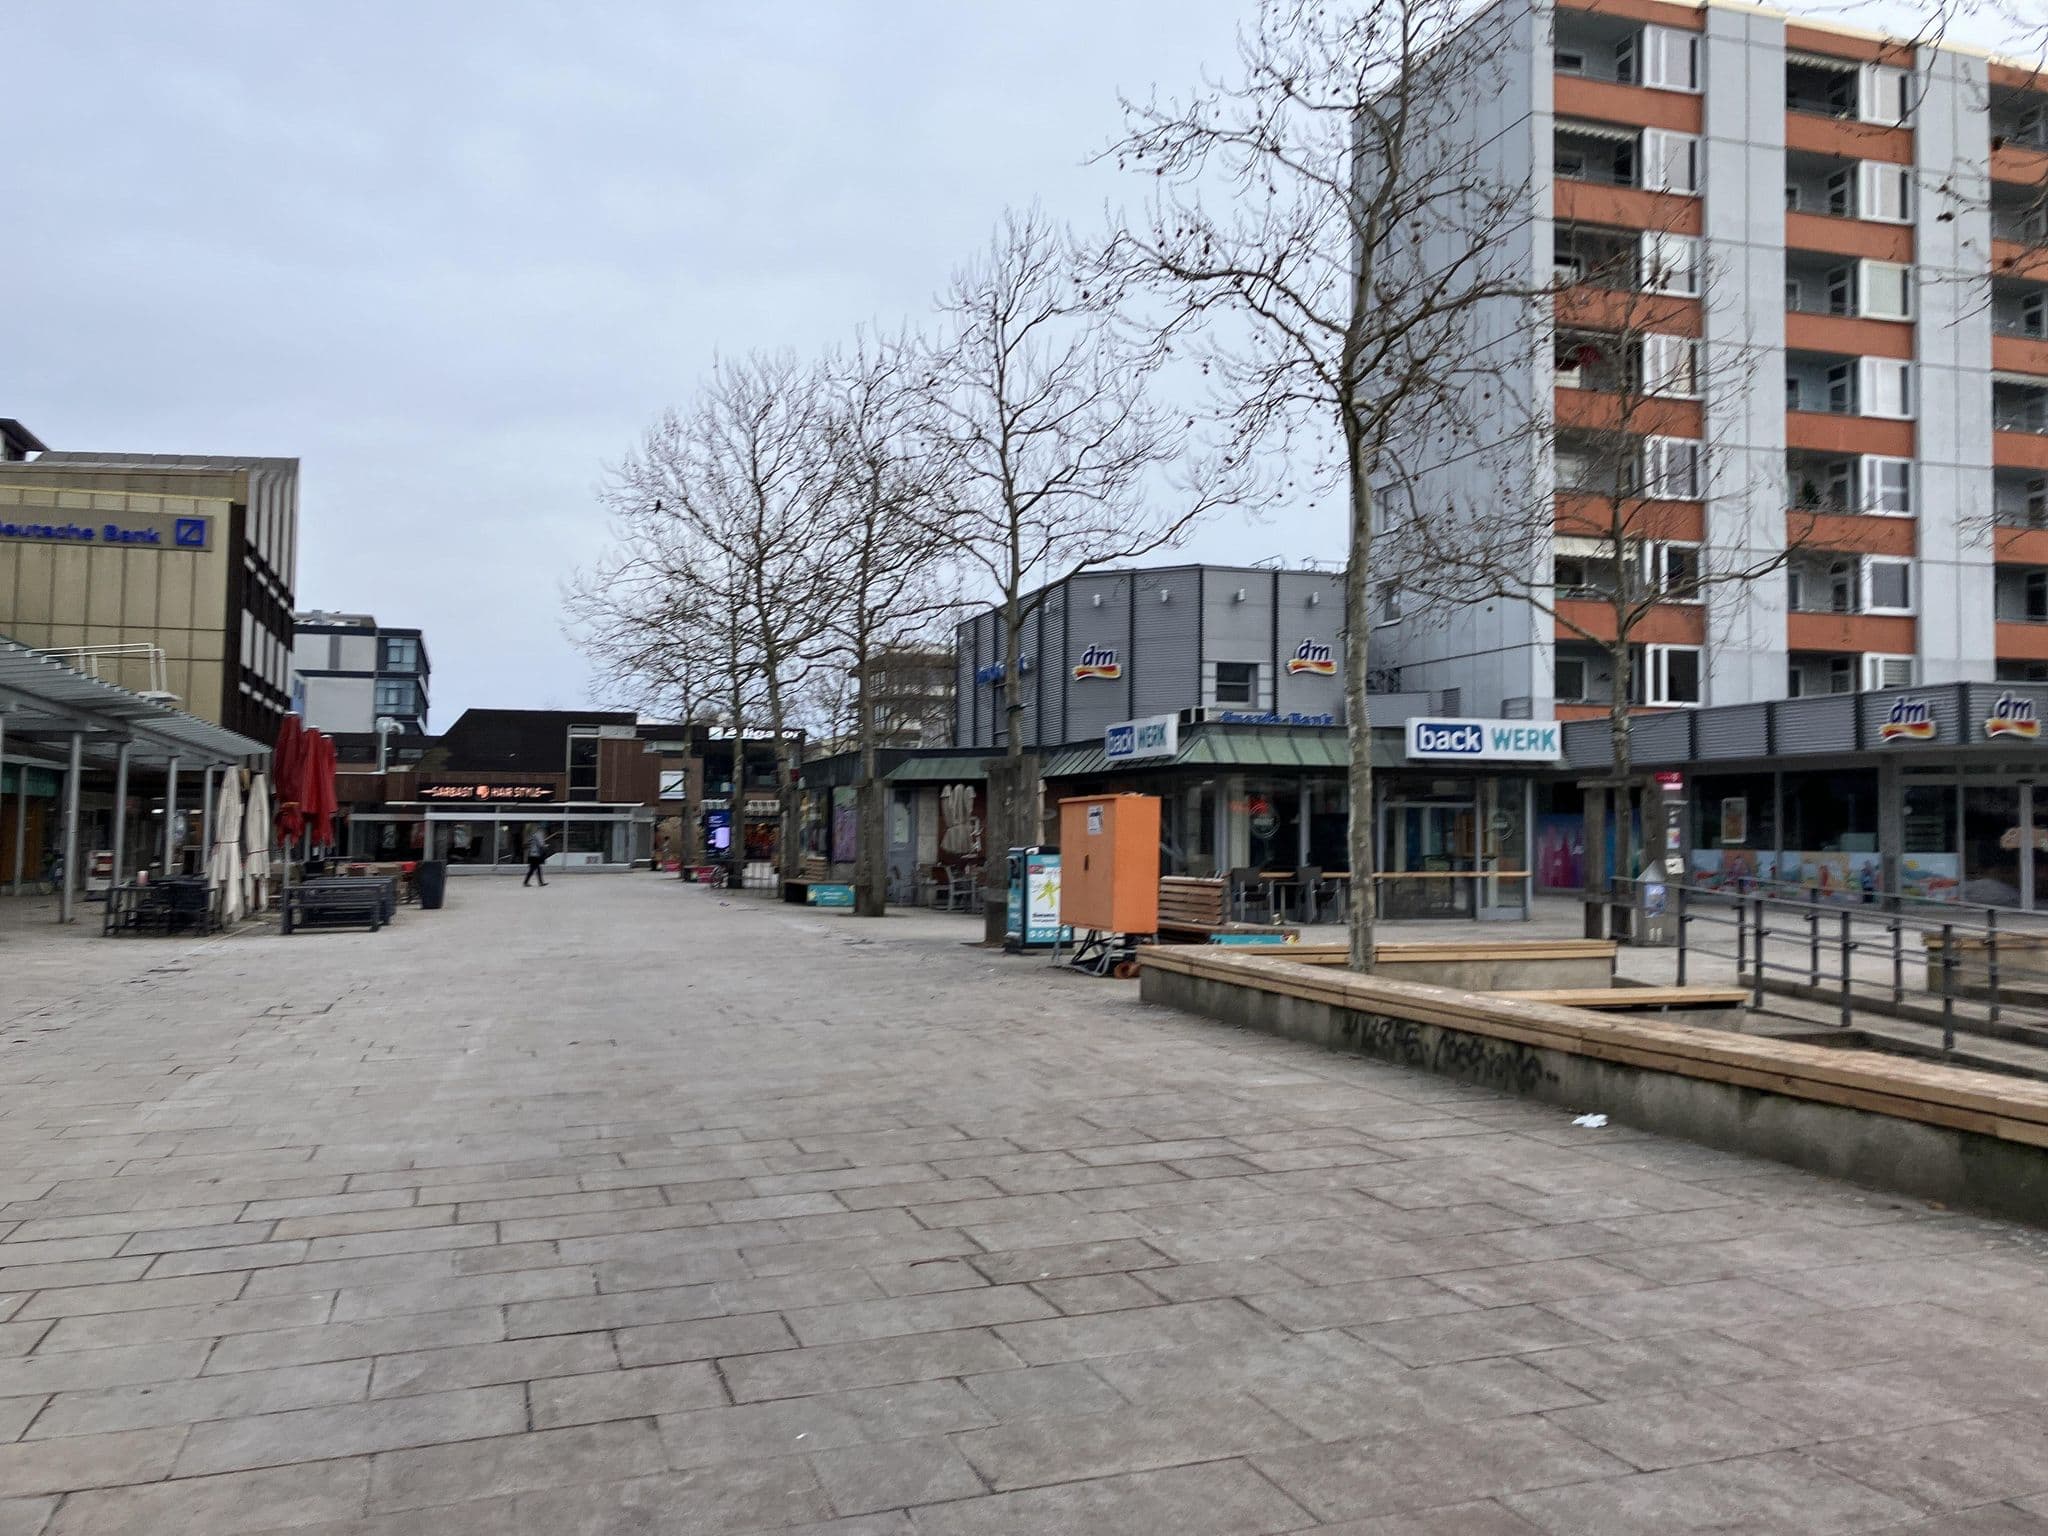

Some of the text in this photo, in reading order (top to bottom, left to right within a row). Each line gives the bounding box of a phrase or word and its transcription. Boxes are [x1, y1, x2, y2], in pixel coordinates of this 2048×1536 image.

[0, 521, 160, 543] eutsche Bank
[1890, 696, 1925, 723] dm
[1996, 692, 2033, 720] dm
[1419, 724, 1556, 752] back WERK
